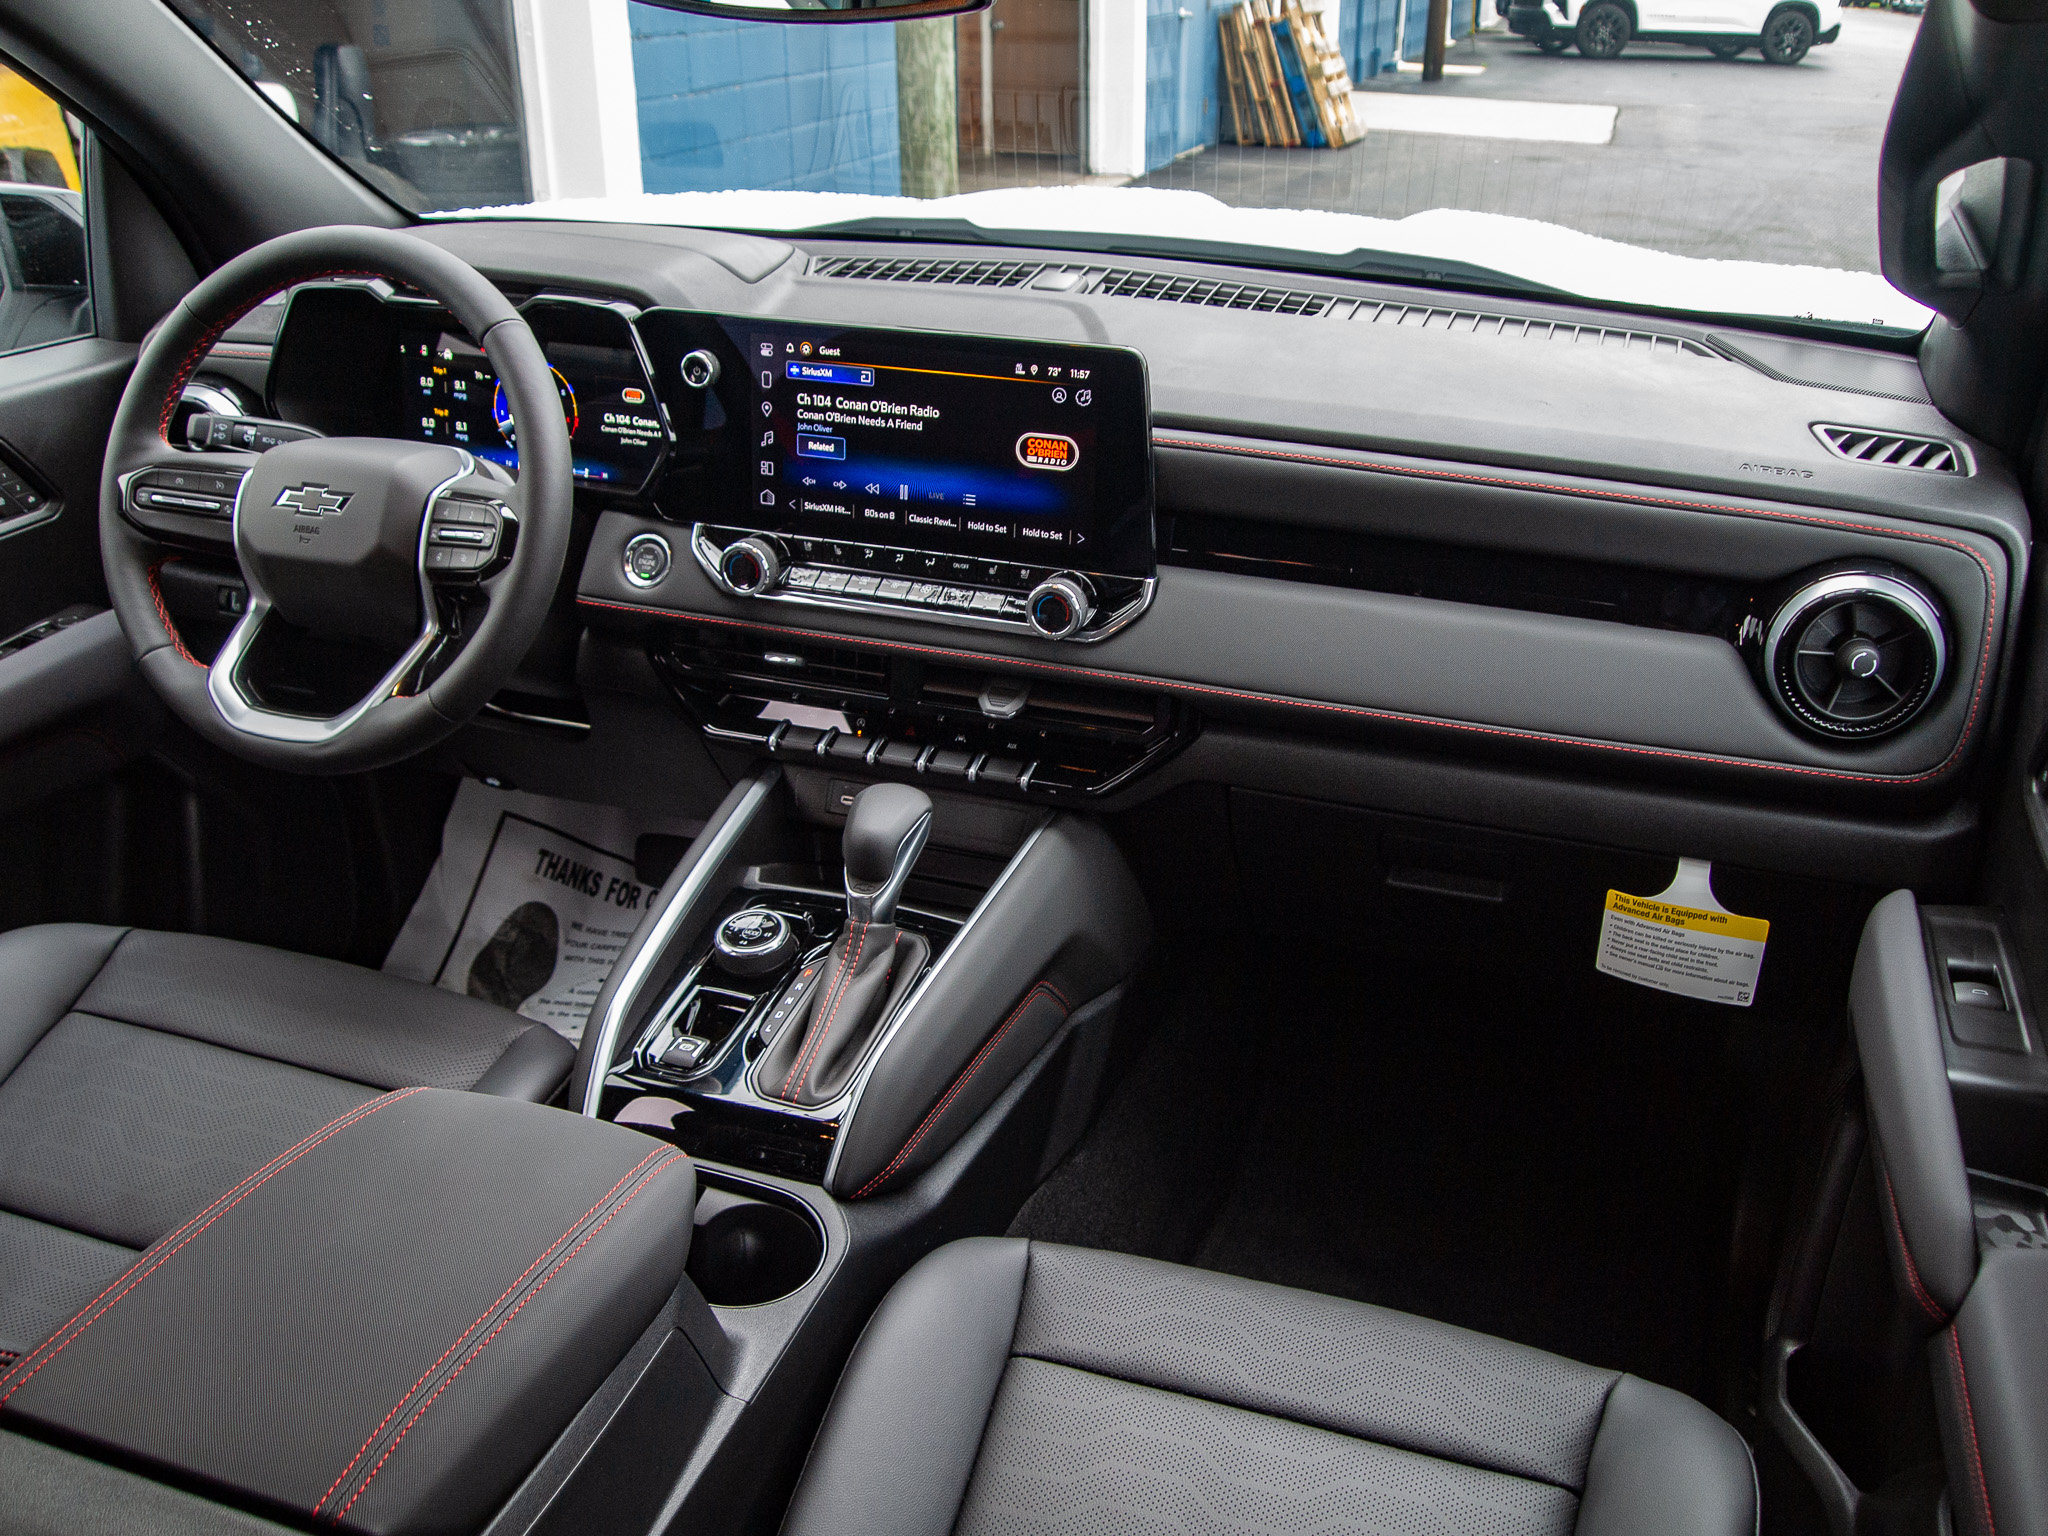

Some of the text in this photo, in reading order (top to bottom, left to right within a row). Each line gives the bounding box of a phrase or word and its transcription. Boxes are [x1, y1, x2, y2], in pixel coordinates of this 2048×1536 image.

[819, 346, 841, 356] Guest
[802, 366, 832, 378] SiriusXM
[1070, 368, 1090, 380] 11:57
[454, 392, 468, 401] mpg
[797, 392, 940, 418] Ch 104 Conan O'Brien Radio
[604, 412, 615, 424] Ch
[616, 414, 630, 426] 104
[797, 409, 923, 432] Conan O'Brien Needs A Friend
[601, 424, 618, 434] Conan
[796, 422, 832, 434] John Oliver
[808, 441, 834, 452] Related
[1027, 437, 1068, 451] CONAN
[1026, 447, 1068, 460] O'BRIEN
[1038, 457, 1068, 466] RADIO
[1739, 462, 1814, 480] AIRBAG
[804, 501, 834, 513] SiriusXM
[864, 508, 878, 518] 80s
[879, 512, 889, 520] on
[909, 514, 933, 525] Classic
[293, 524, 320, 535] AIRBAG
[968, 520, 1007, 534] Hold to Set
[1022, 527, 1063, 541] Hold to Set
[536, 848, 604, 898] THANKS
[605, 877, 638, 910] FOR
[1613, 902, 1686, 926] Advanced Air Bags
[1615, 894, 1630, 904] This
[1633, 898, 1660, 912] Vehicle
[1671, 907, 1708, 920] Equipped
[1710, 915, 1728, 924] with
[1610, 914, 1624, 922] Even
[1636, 922, 1662, 932] Advanced
[1672, 930, 1685, 938] Bags
[1614, 924, 1634, 934] Children
[1652, 934, 1666, 942] killed
[1674, 940, 1698, 950] seriously
[1698, 944, 1717, 952] injured
[804, 968, 812, 978] P
[794, 982, 804, 990] R
[784, 996, 794, 1005] N
[774, 1010, 784, 1018] D
[765, 1024, 772, 1032] L
